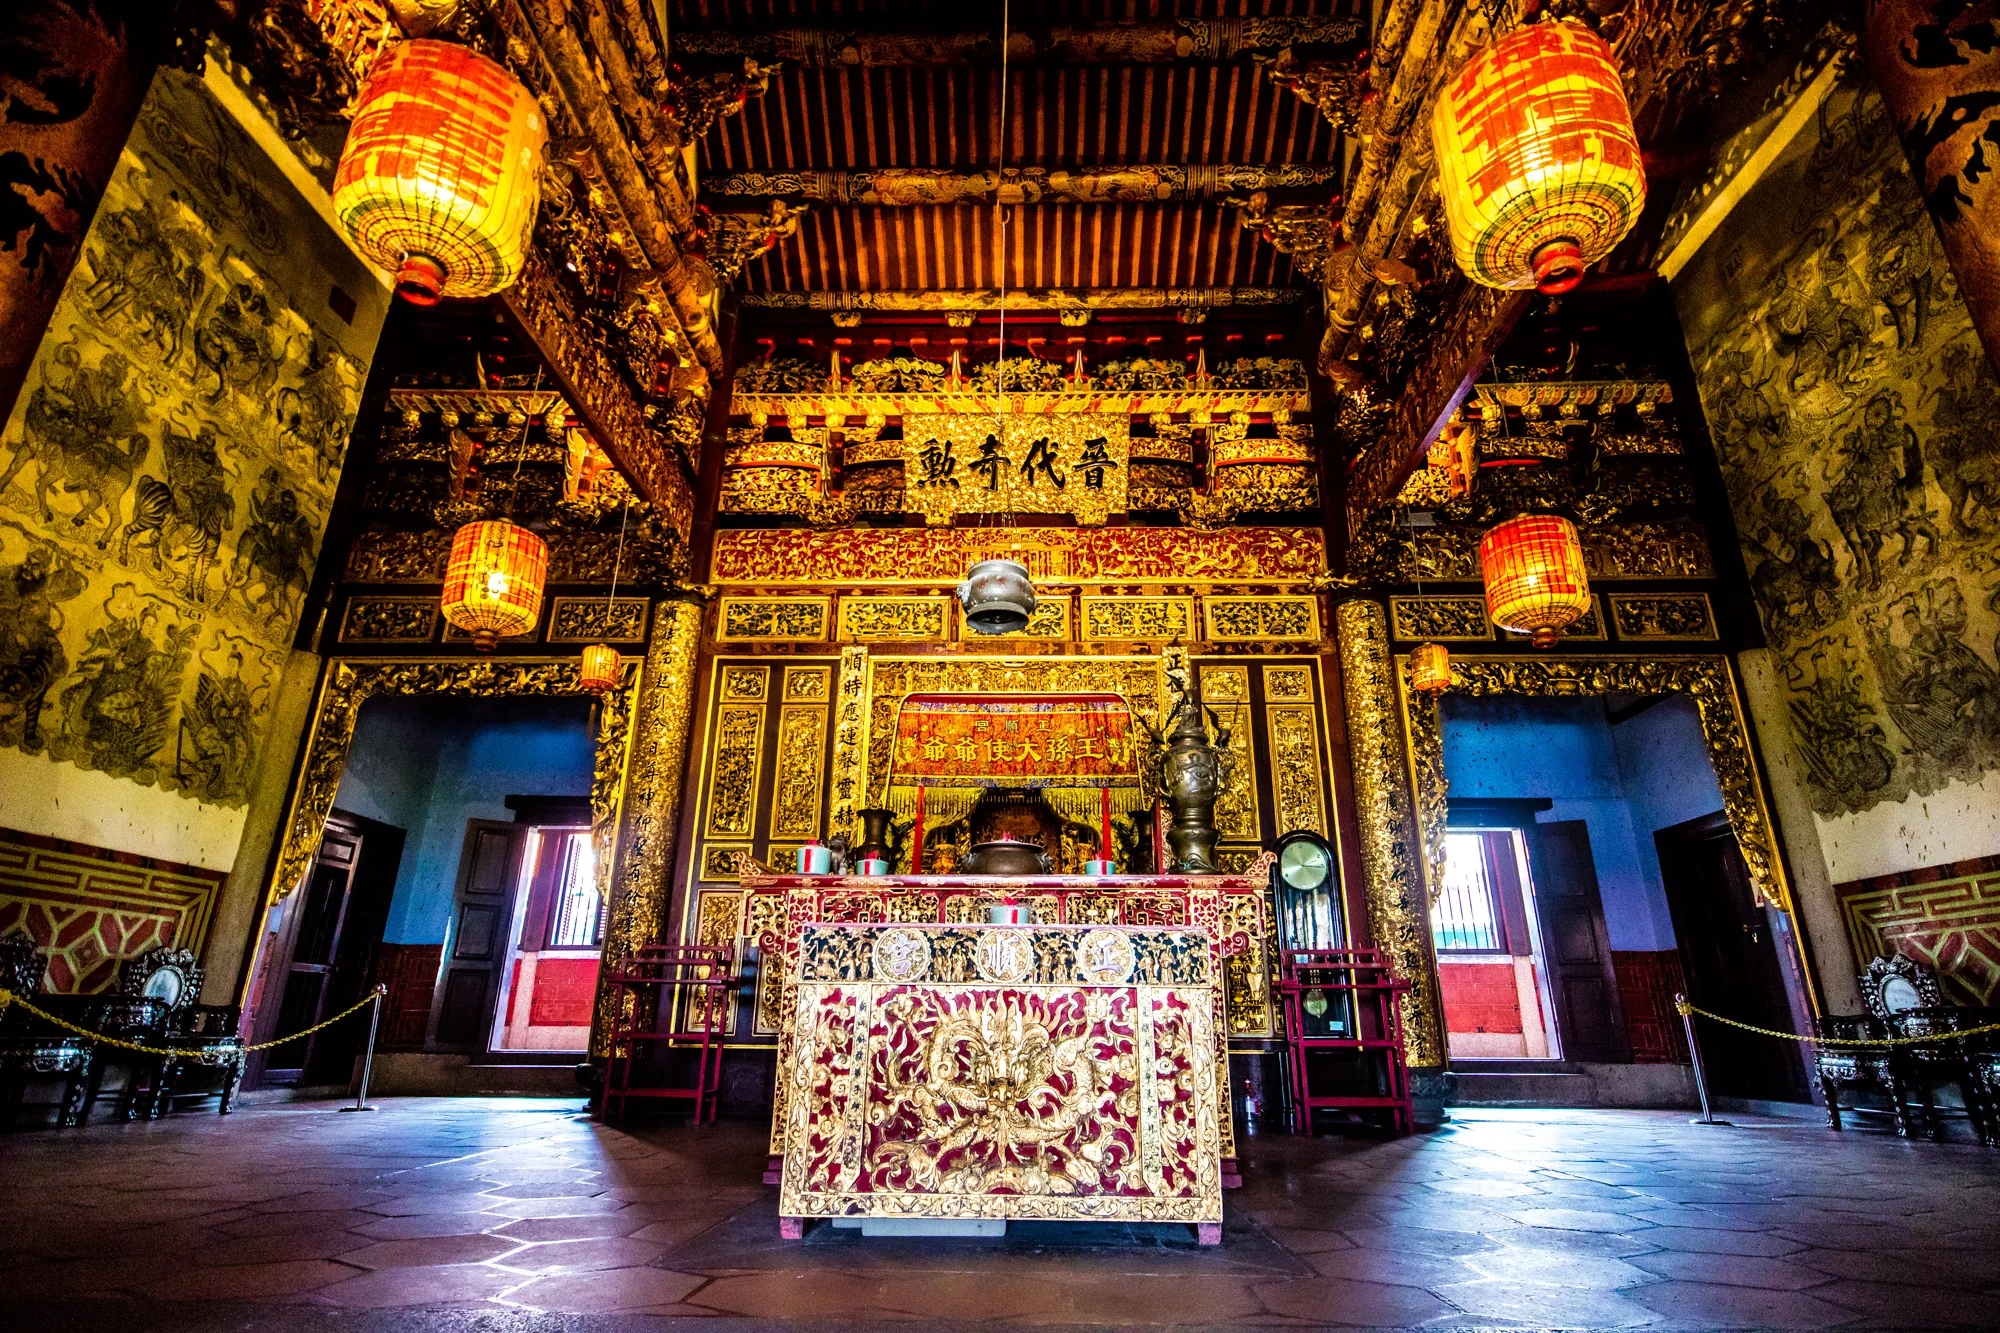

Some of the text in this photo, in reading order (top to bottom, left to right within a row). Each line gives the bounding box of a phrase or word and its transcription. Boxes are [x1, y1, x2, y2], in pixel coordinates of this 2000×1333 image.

[921, 737, 1104, 763] 王孫大使爺爺
